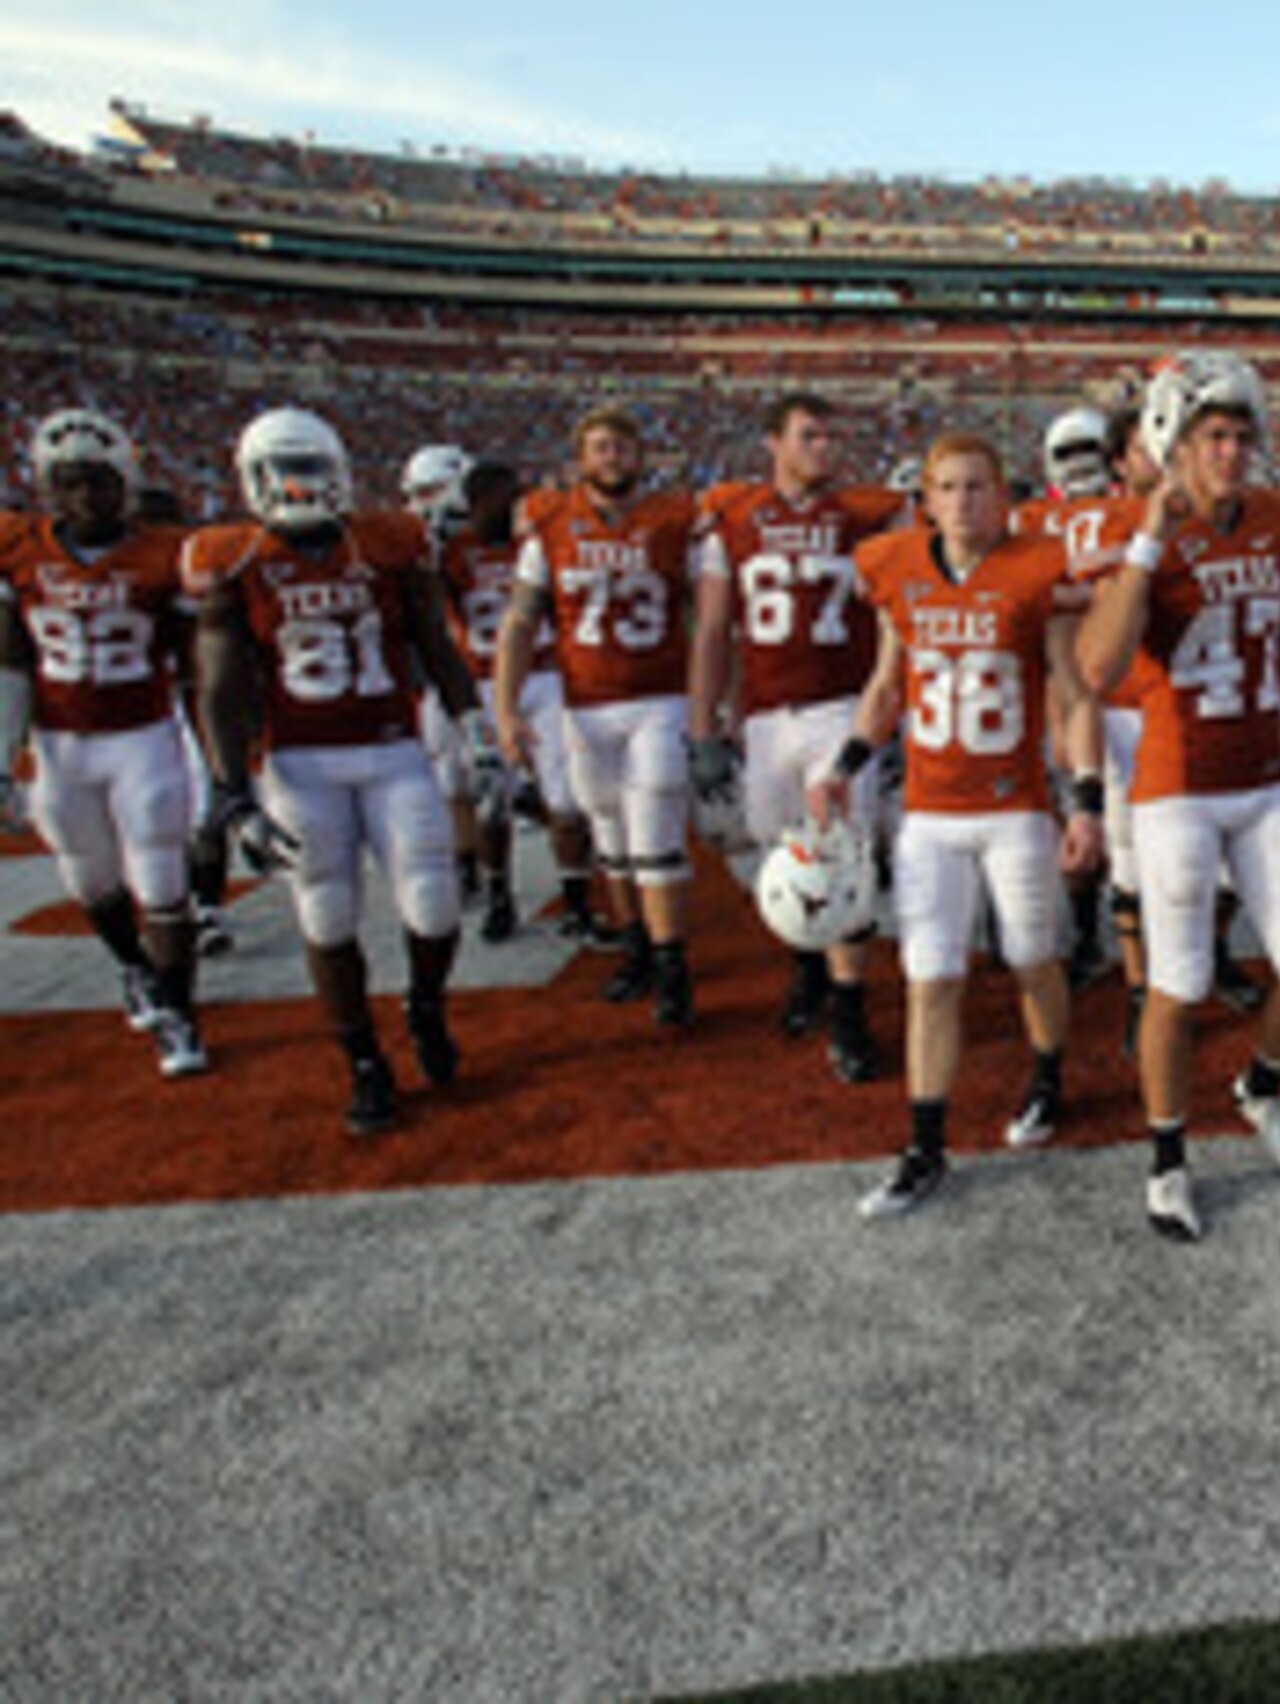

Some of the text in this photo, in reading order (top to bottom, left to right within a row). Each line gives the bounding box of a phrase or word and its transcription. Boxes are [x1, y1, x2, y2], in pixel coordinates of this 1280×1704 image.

[556, 568, 668, 648] 73
[737, 553, 858, 645] 67
[274, 608, 398, 700] 81
[906, 648, 1026, 757] 38
